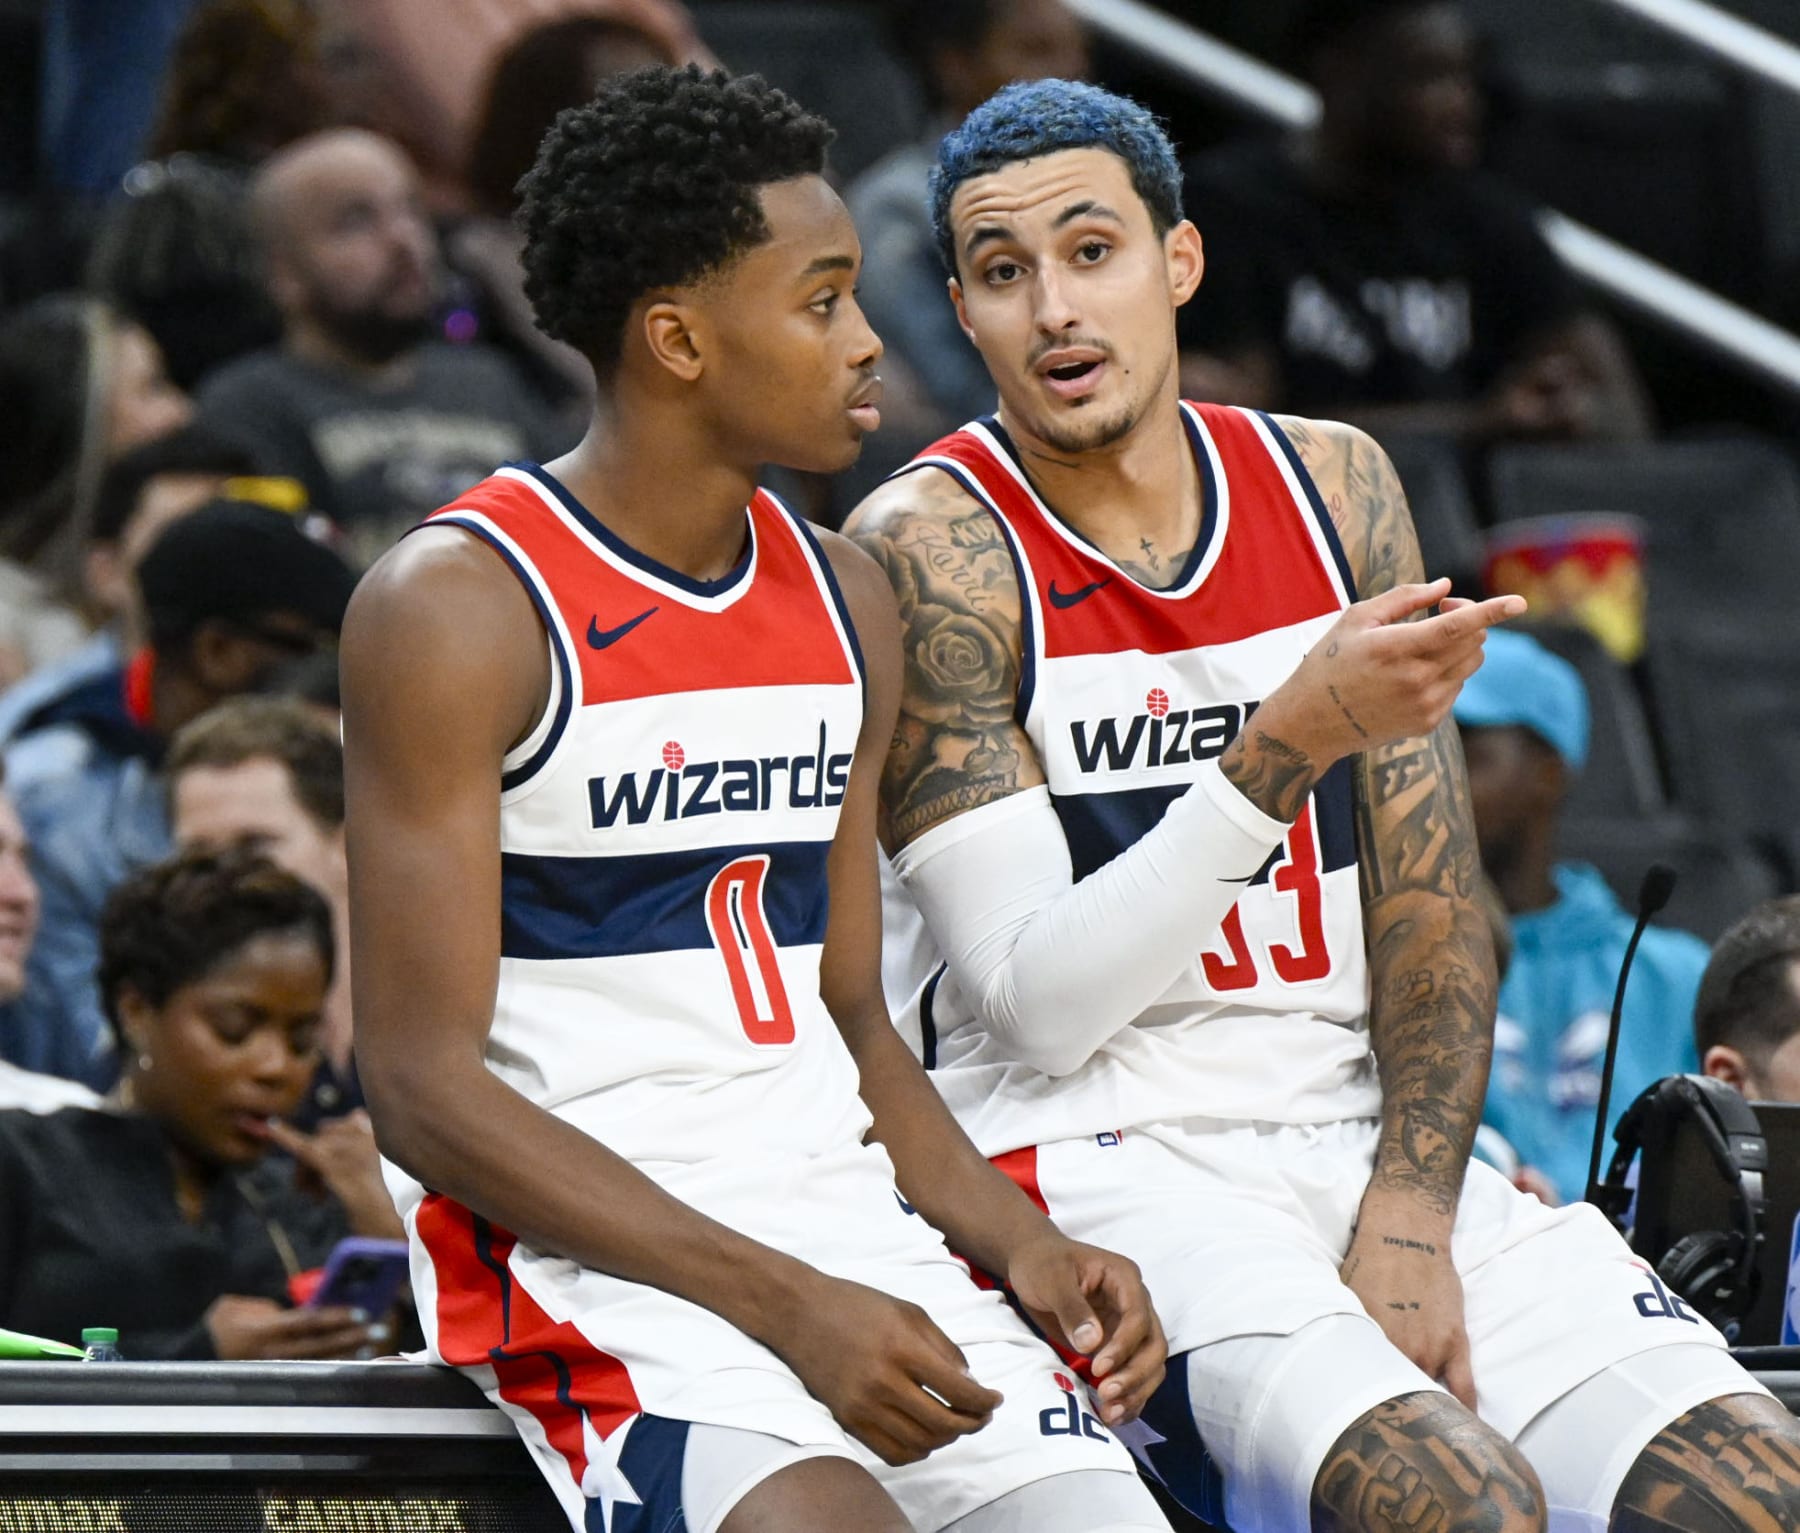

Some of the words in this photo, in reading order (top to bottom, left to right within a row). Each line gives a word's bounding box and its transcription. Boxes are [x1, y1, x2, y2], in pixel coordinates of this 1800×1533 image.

[588, 719, 853, 829] wizards
[706, 857, 797, 1047] 0
[1039, 1389, 1110, 1444] dc
